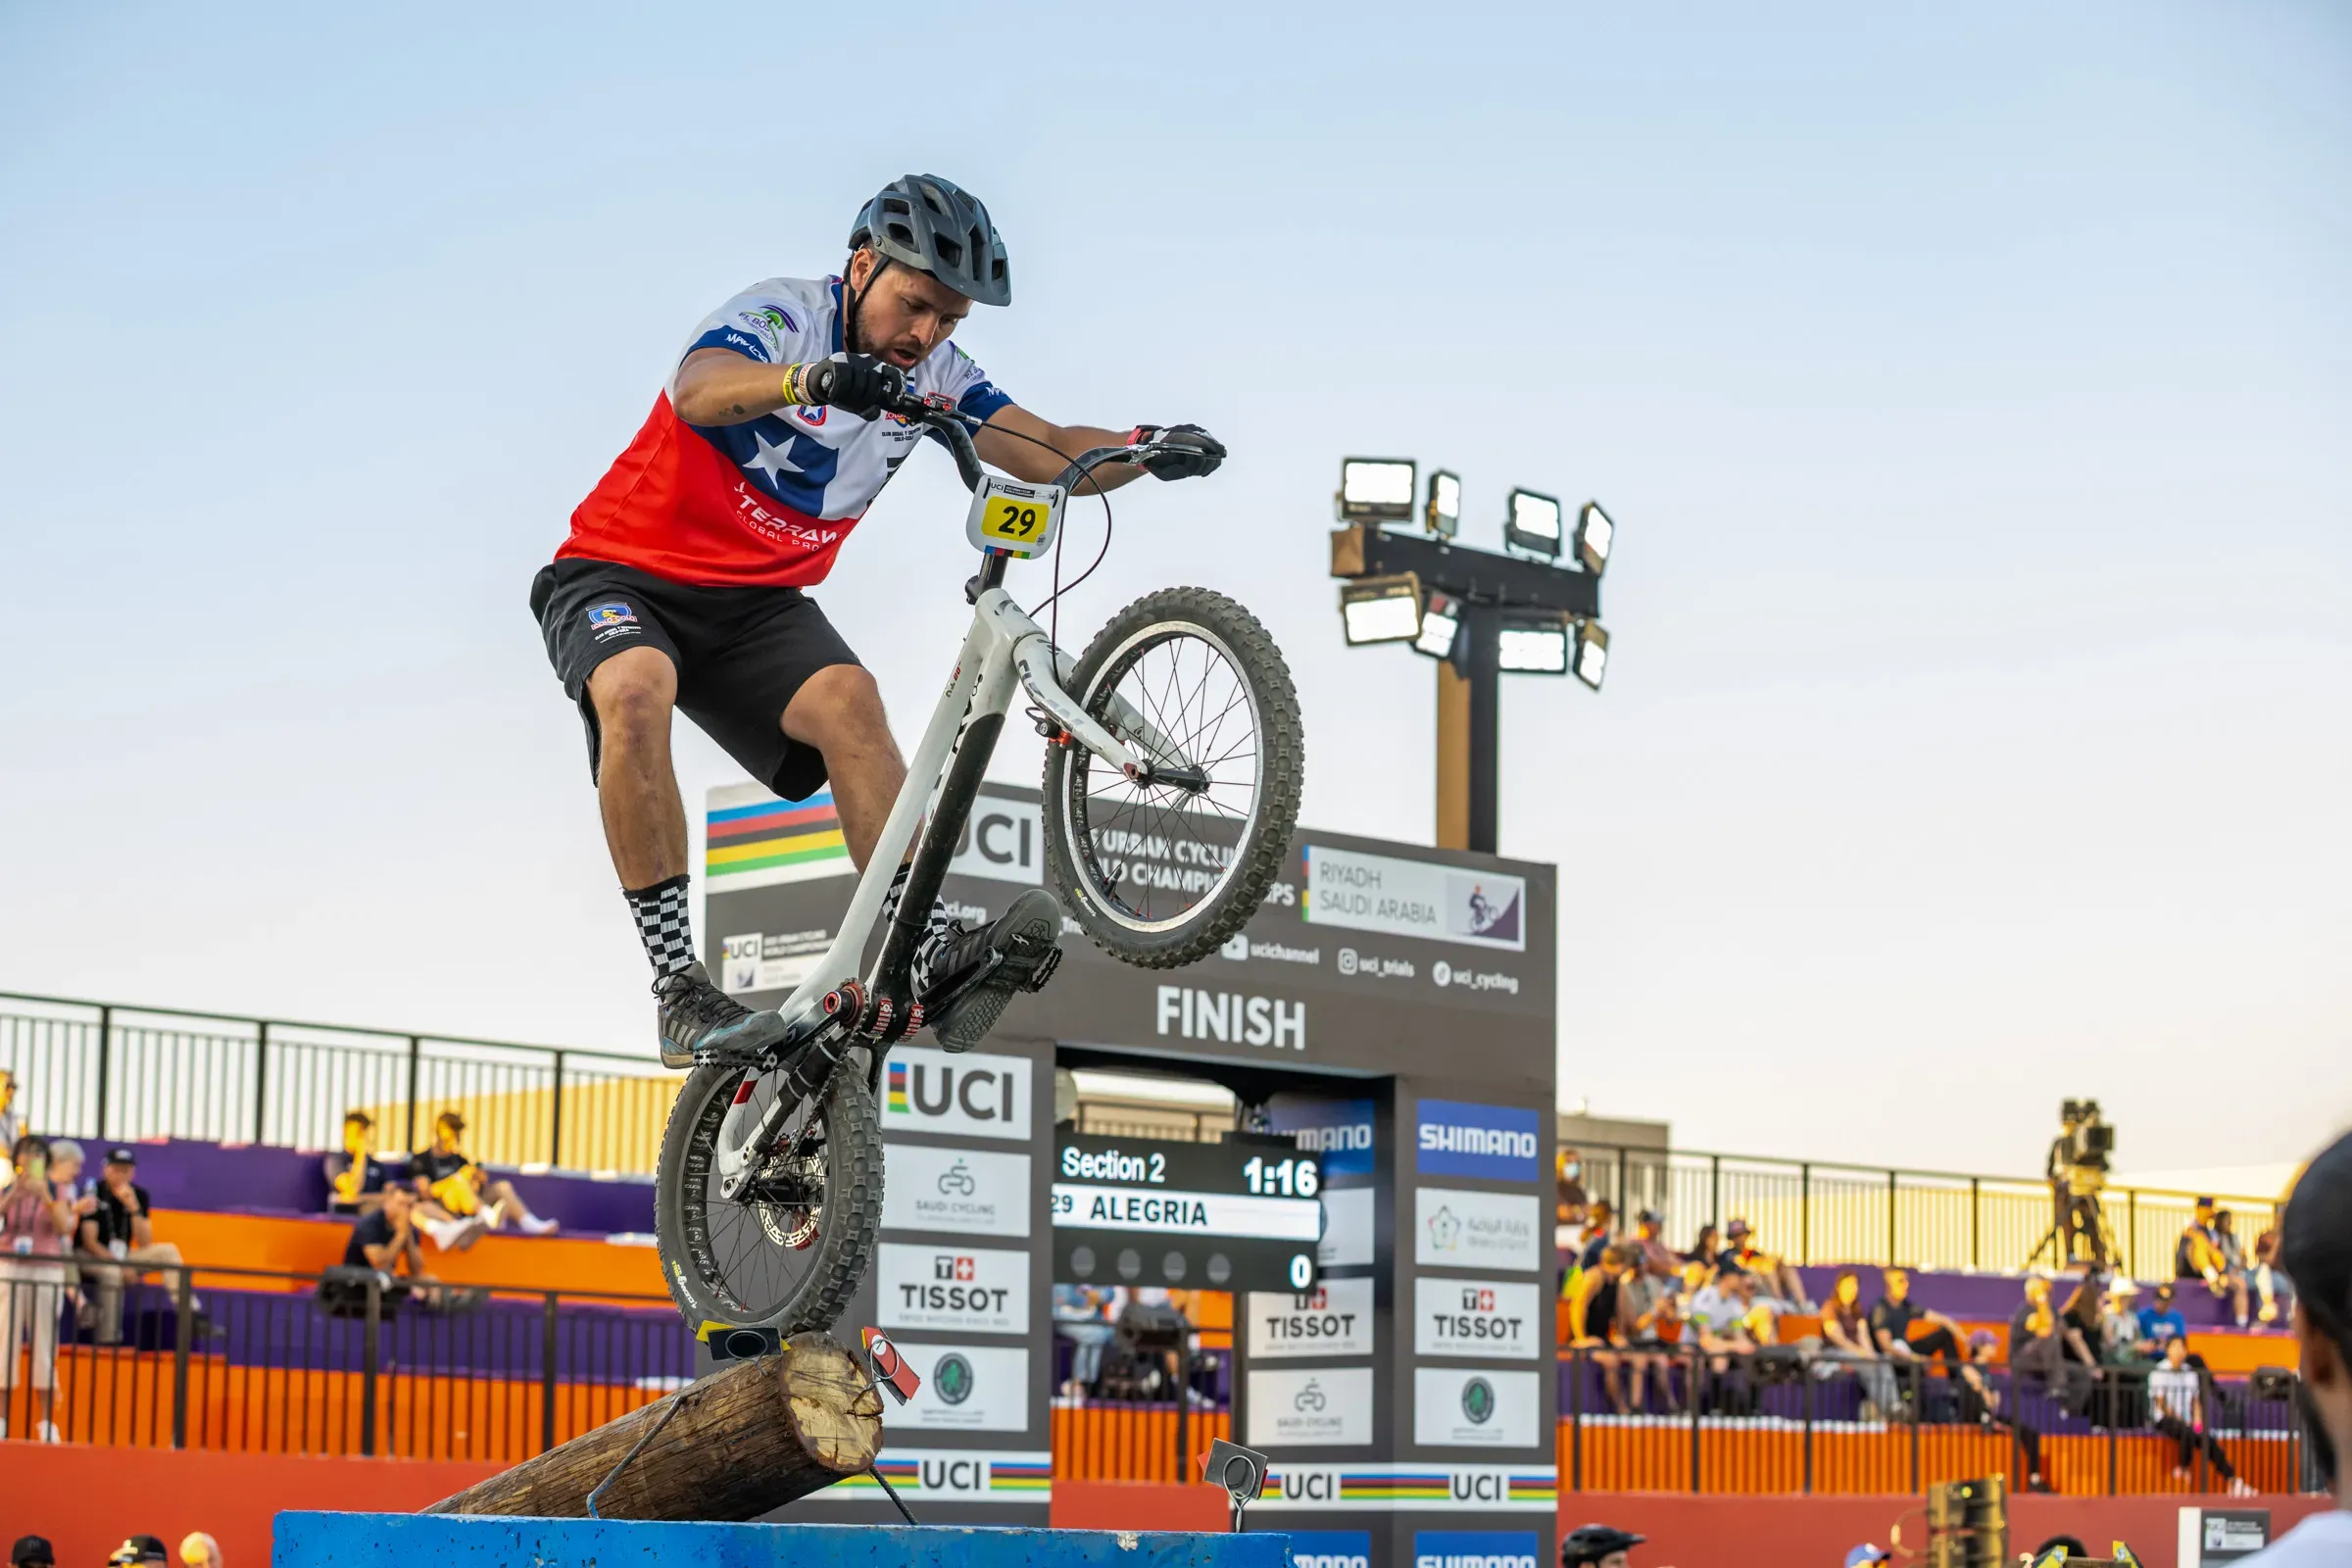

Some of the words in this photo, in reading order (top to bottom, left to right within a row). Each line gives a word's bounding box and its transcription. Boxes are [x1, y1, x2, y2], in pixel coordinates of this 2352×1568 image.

[990, 482, 1004, 491] UCI
[740, 494, 842, 544] TERRAW
[998, 506, 1036, 537] 29
[792, 539, 820, 552] PRO
[1102, 829, 1166, 859] URBAN
[1175, 840, 1237, 868] CYCLI
[1319, 861, 1382, 890] RIYADH
[1319, 890, 1371, 916] SAUDI
[1377, 897, 1438, 925] ARABIA
[730, 939, 759, 958] UCI
[1250, 942, 1320, 964] ucichannel
[1358, 956, 1415, 978] uci_trials
[1453, 969, 1519, 995] uci_cycling
[1156, 985, 1305, 1051] FINISH
[913, 1064, 1013, 1123] UCI
[1296, 1123, 1372, 1152] MANO
[1418, 1123, 1538, 1158] SHIMANO
[1061, 1146, 1147, 1182] Section
[1149, 1152, 1166, 1183] 2
[1244, 1155, 1318, 1198] 1:16
[1051, 1195, 1073, 1213] 29
[1090, 1195, 1207, 1226] ALEGRIA
[1290, 1253, 1312, 1289] 0
[899, 1283, 1008, 1313] TISSOT
[1265, 1314, 1355, 1339] TISSOT
[1433, 1314, 1523, 1341] TISSOT
[922, 1460, 980, 1491] UCI
[1285, 1473, 1332, 1500] UCI
[1453, 1473, 1501, 1501] UCI
